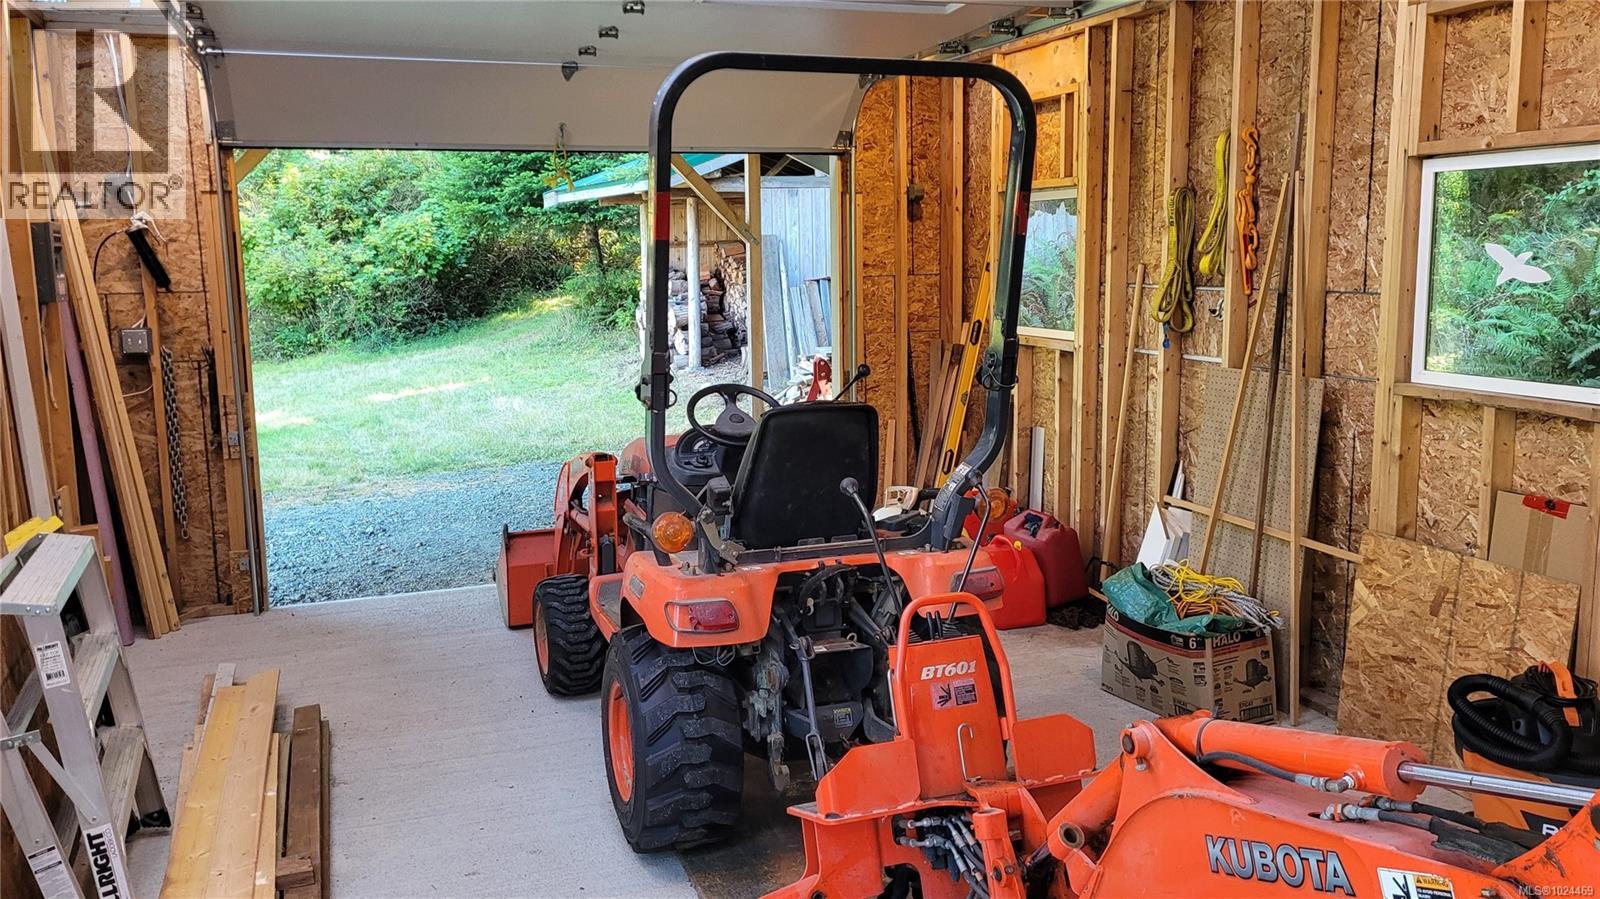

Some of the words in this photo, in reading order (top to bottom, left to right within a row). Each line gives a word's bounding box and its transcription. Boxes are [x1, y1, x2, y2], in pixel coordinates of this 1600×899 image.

[1213, 631, 1241, 648] HALO
[920, 660, 977, 681] BT601
[1204, 834, 1357, 897] KUBOTA
